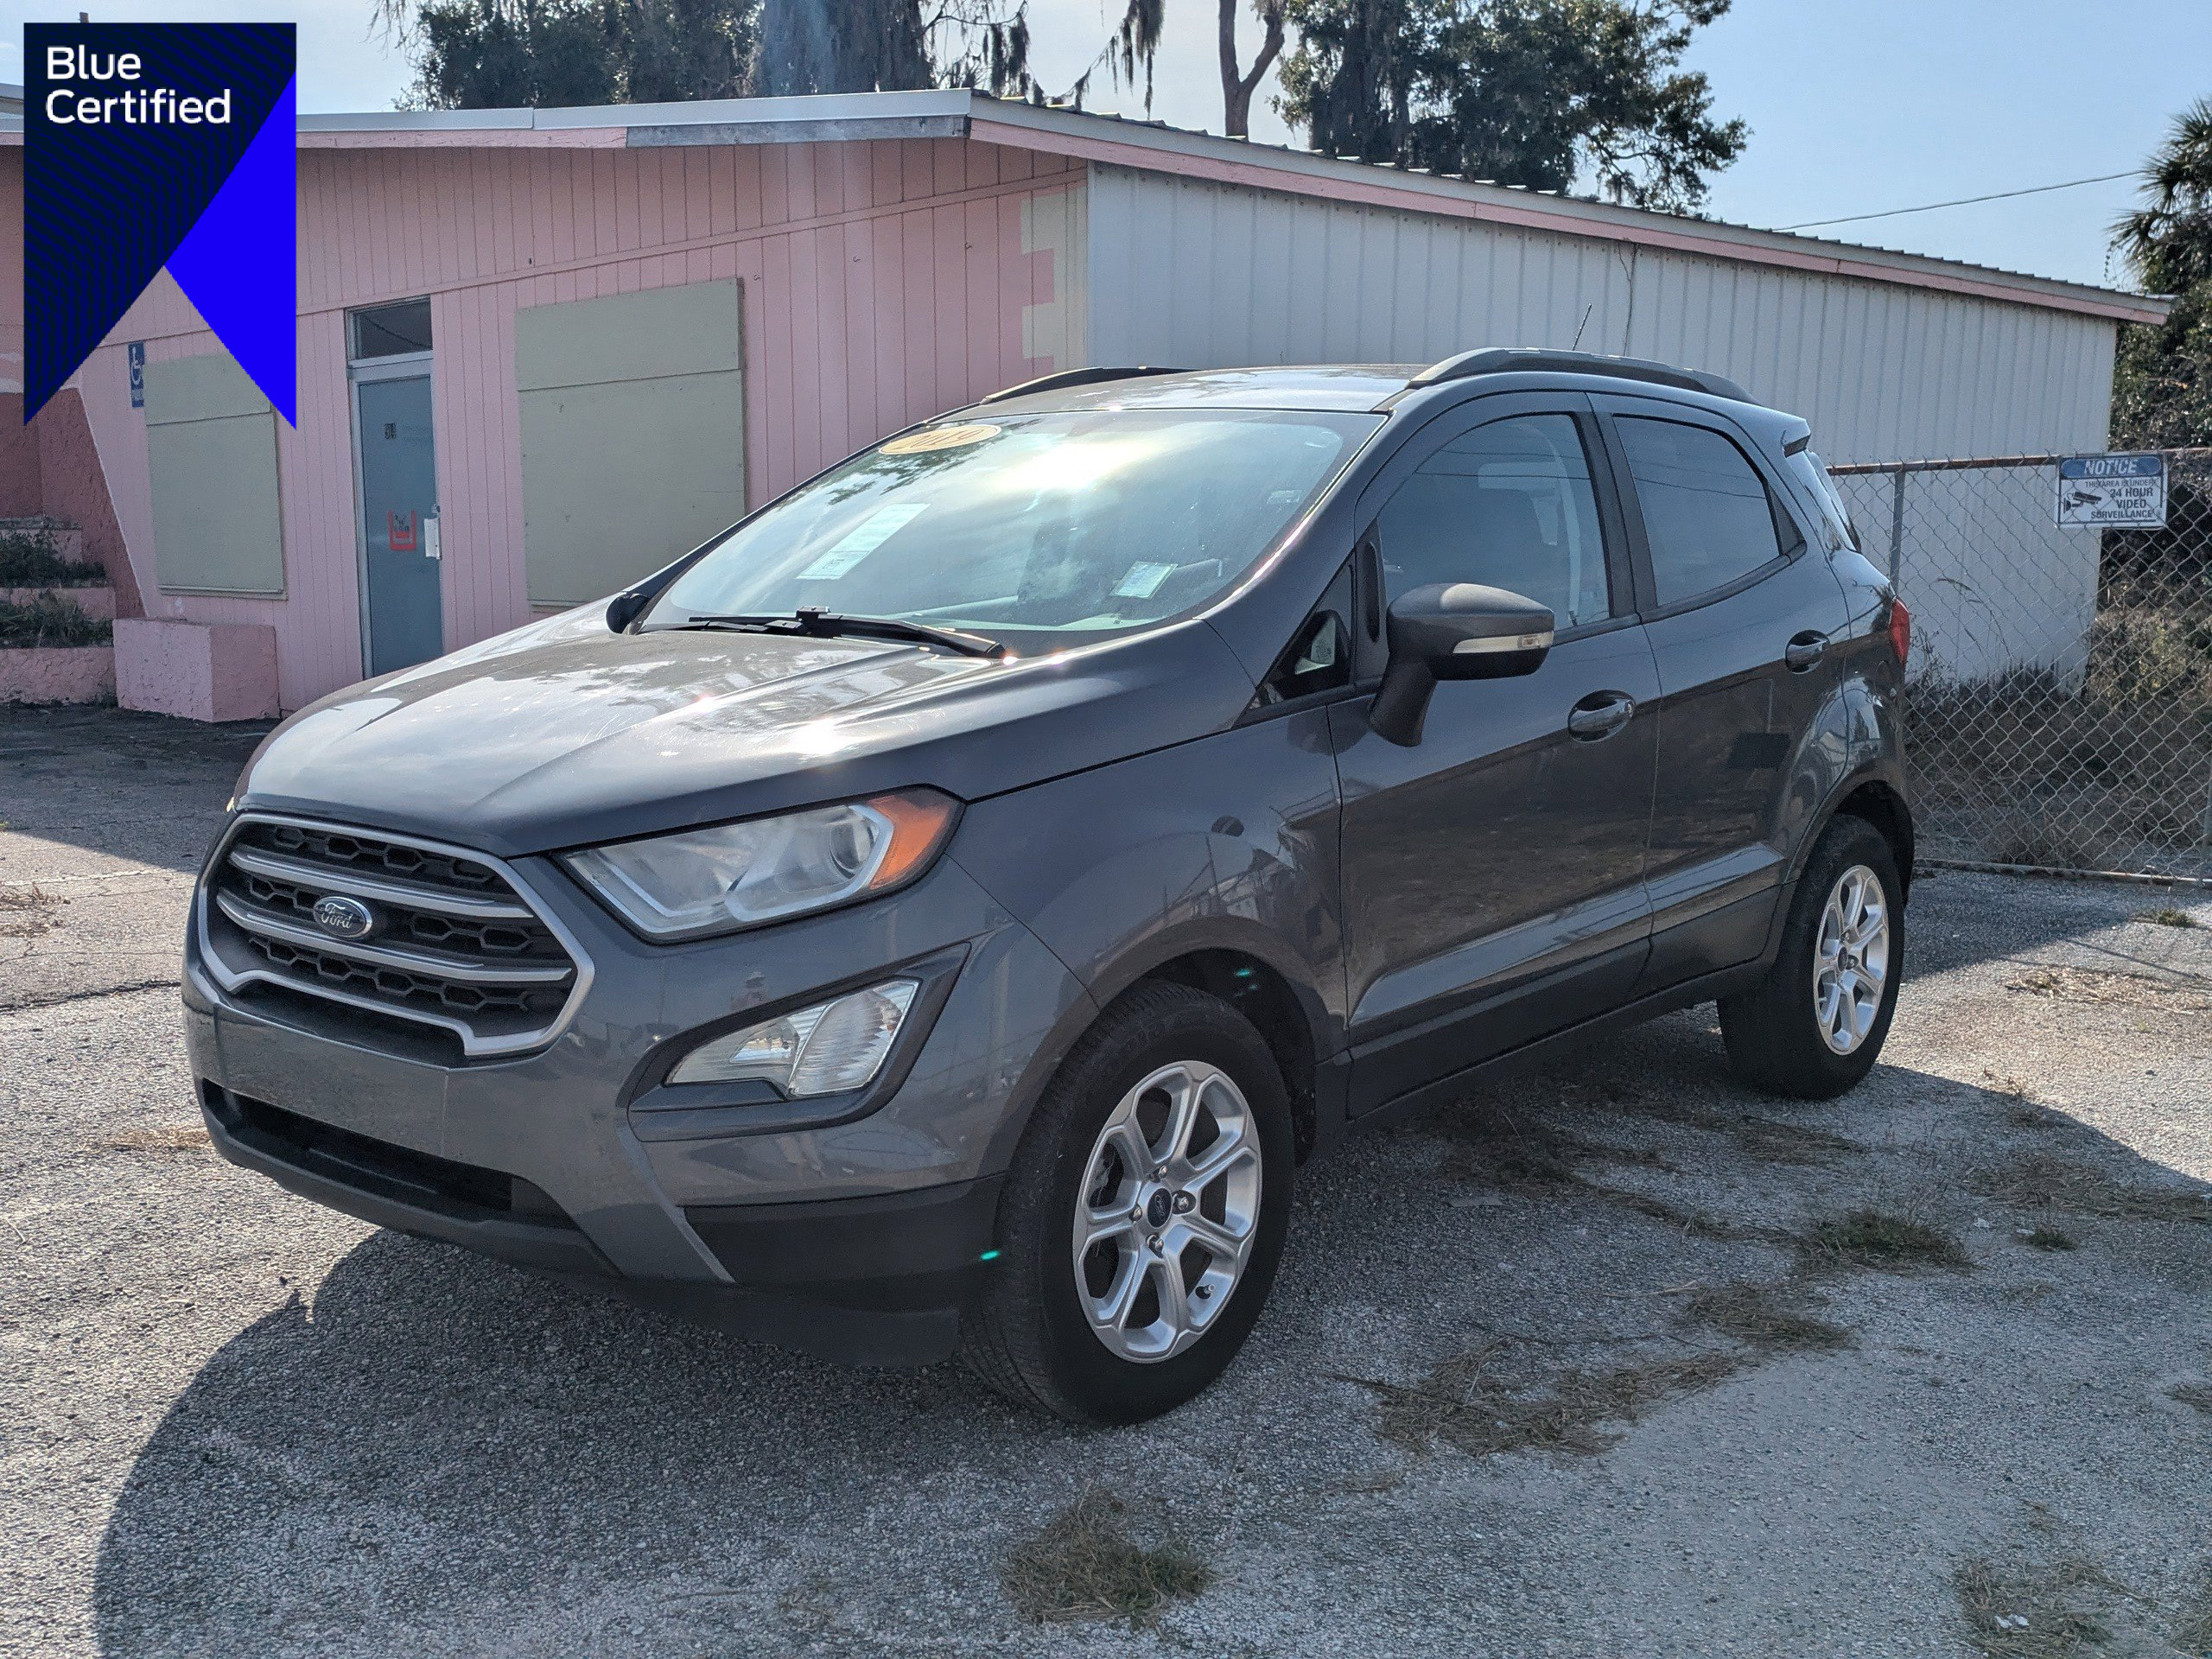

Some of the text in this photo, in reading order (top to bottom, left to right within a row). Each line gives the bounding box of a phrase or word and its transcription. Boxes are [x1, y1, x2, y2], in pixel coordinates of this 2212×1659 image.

[2084, 459, 2139, 475] NOTICE
[2110, 487, 2153, 498] 24 HOUR
[2117, 499, 2146, 509] VIDEO
[2091, 510, 2152, 519] SURVEILLANCE
[321, 902, 353, 929] Ford
